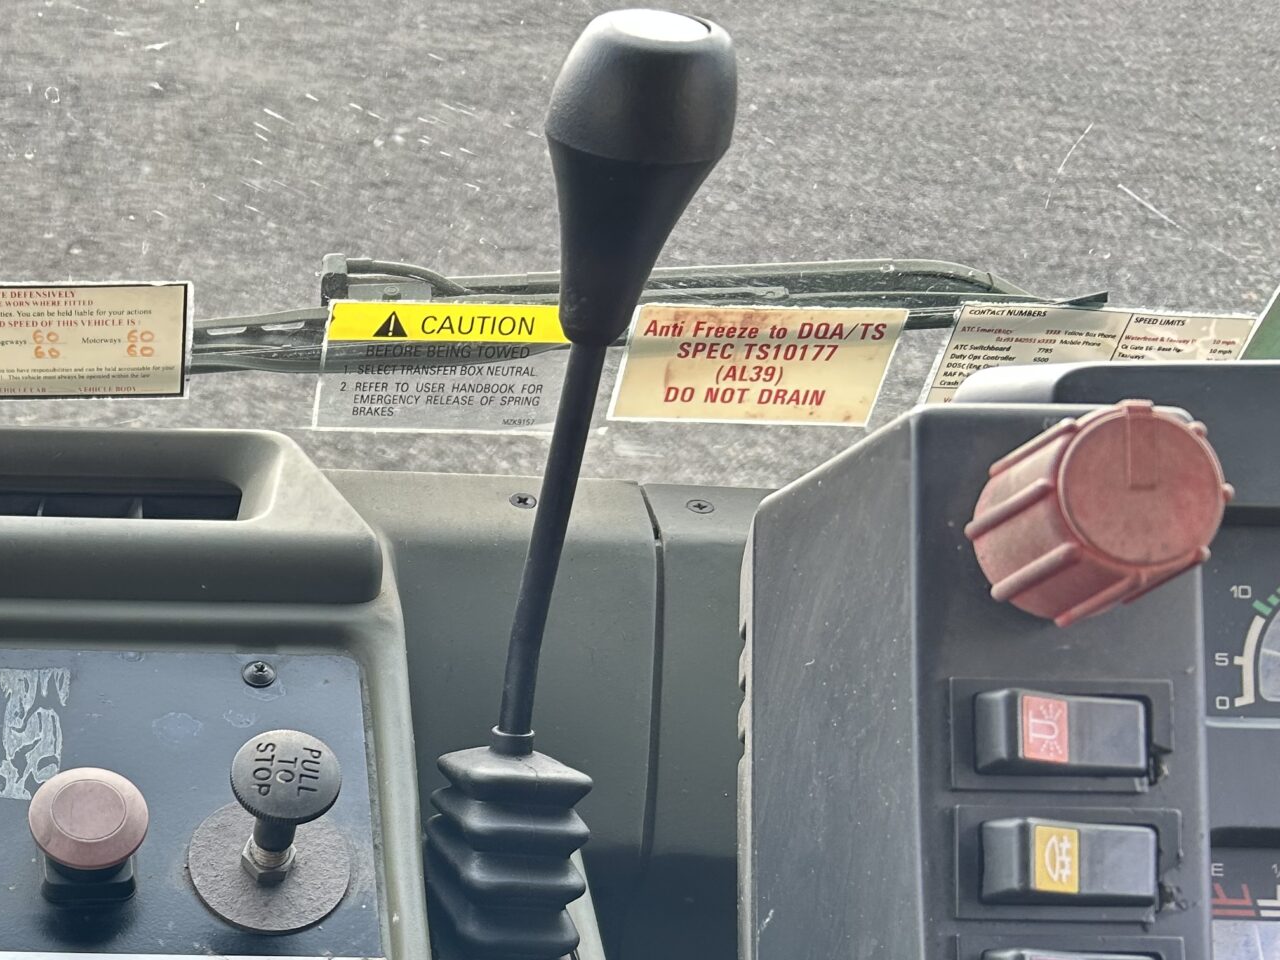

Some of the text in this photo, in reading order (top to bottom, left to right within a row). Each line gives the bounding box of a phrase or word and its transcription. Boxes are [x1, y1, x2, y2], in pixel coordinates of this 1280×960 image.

[10, 290, 76, 299] DEFENSIVELY
[75, 309, 94, 317] liable
[1006, 310, 1048, 318] NUMBERS
[8, 320, 38, 328] SPEED
[57, 319, 78, 327] THIS
[81, 319, 123, 327] VEHICLE
[420, 315, 536, 336] CAUTION
[1134, 316, 1186, 327] SPEED LIMITS
[127, 329, 155, 343] 60
[644, 319, 684, 338] Anti
[692, 320, 759, 339] Freeze
[770, 323, 788, 340] to
[32, 330, 59, 344] 60
[82, 337, 121, 345] Motorways
[34, 345, 60, 359] 60
[127, 344, 155, 357] 60
[366, 345, 531, 360] BEFORE BEING TOWED
[677, 343, 839, 361] SPEC TS10177
[357, 364, 402, 376] SELECT
[400, 365, 456, 376] TRANSFER
[460, 365, 484, 377] BOX
[716, 365, 784, 386] (AL39)
[354, 382, 543, 395] REFER TO USER HANDBOOK FOR
[353, 394, 540, 407] EMERGENCY RELEASE OF SPRING
[664, 386, 826, 406] DO NOT DRAIN
[1230, 585, 1252, 599] 10
[1214, 652, 1229, 666] 5
[1216, 696, 1230, 710] 0
[252, 742, 277, 797] STOP
[276, 757, 298, 784] TO
[297, 747, 322, 797] PULL
[1211, 863, 1224, 877] E
